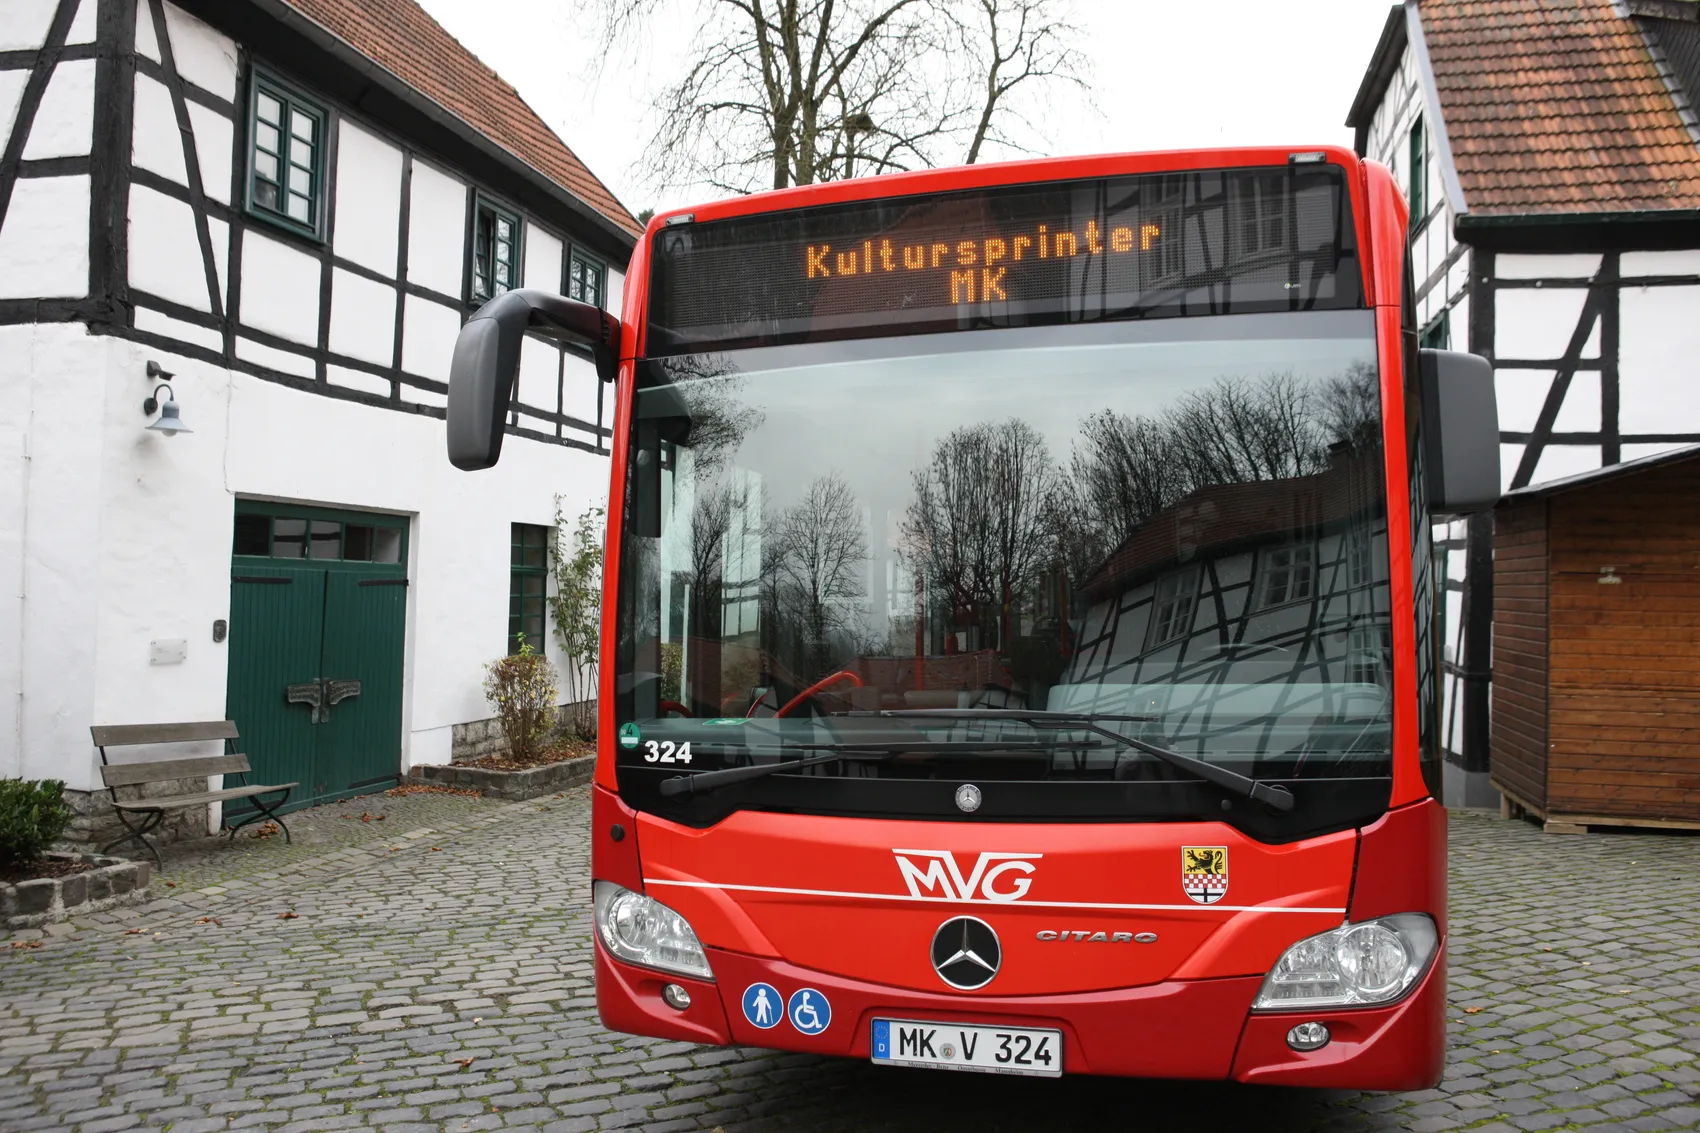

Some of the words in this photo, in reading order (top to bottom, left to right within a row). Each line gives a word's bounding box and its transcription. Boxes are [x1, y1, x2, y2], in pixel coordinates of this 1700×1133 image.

[807, 220, 1160, 278] Kultursprinter
[951, 266, 1007, 304] MK
[626, 724, 633, 736] 4
[644, 740, 693, 764] 324
[892, 848, 1043, 901] MVG
[1036, 930, 1158, 944] CITARO
[878, 1043, 886, 1052] D
[900, 1027, 937, 1058] MK
[960, 1031, 978, 1061] V
[995, 1034, 1052, 1066] 324
